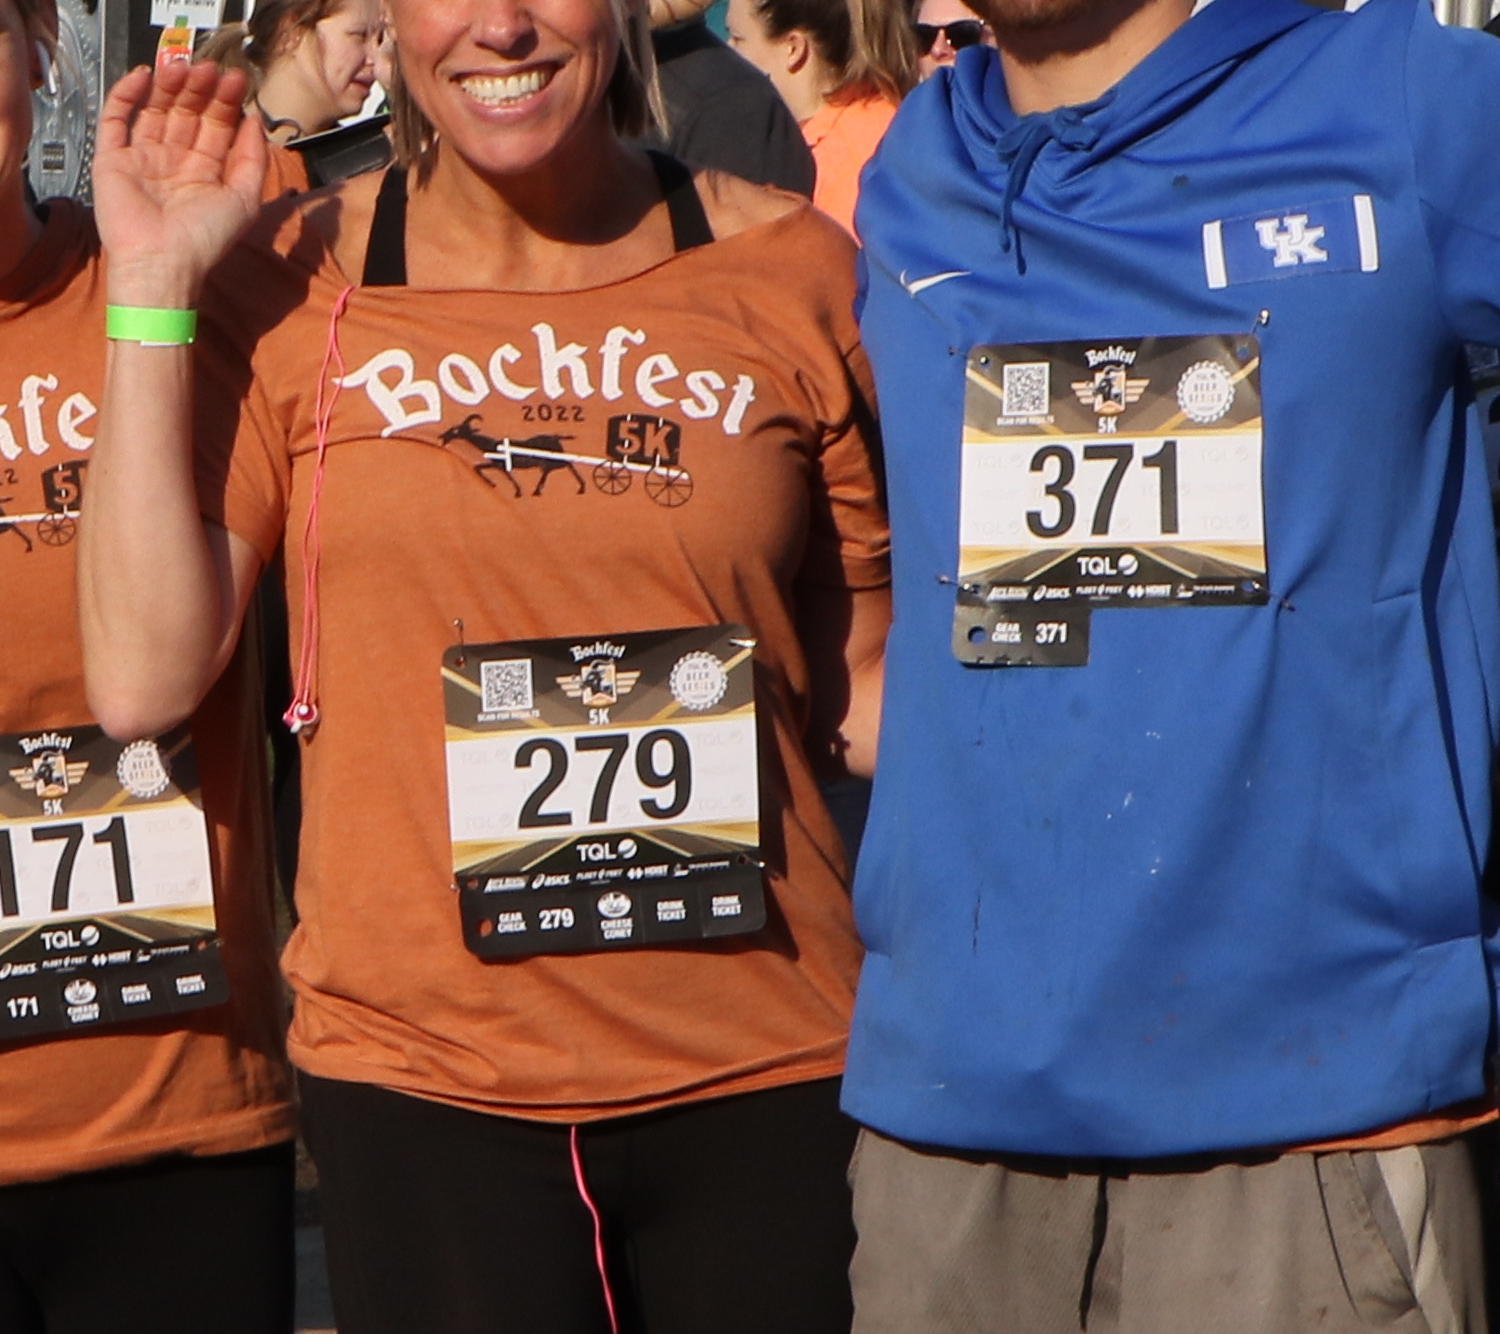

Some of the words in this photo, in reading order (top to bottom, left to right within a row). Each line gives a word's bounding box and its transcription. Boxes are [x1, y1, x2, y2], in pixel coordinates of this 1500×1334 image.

[1255, 214, 1328, 267] UK
[1085, 346, 1137, 368] Bockfest
[332, 321, 755, 436] Bockfest
[522, 405, 585, 422] 2022
[1098, 418, 1117, 433] 5K
[615, 417, 670, 459] 5K
[1025, 440, 1180, 539] 371
[1077, 556, 1117, 576] TQL
[1035, 623, 1068, 644] 371
[569, 640, 626, 662] Bockfest
[589, 709, 610, 726] 5K
[19, 733, 73, 755] Bockfest
[514, 728, 692, 830] 279
[44, 800, 63, 815] 5K
[577, 843, 617, 862] TQL
[538, 908, 574, 930] 279
[41, 929, 80, 950] TQL
[7, 997, 39, 1018] 171
